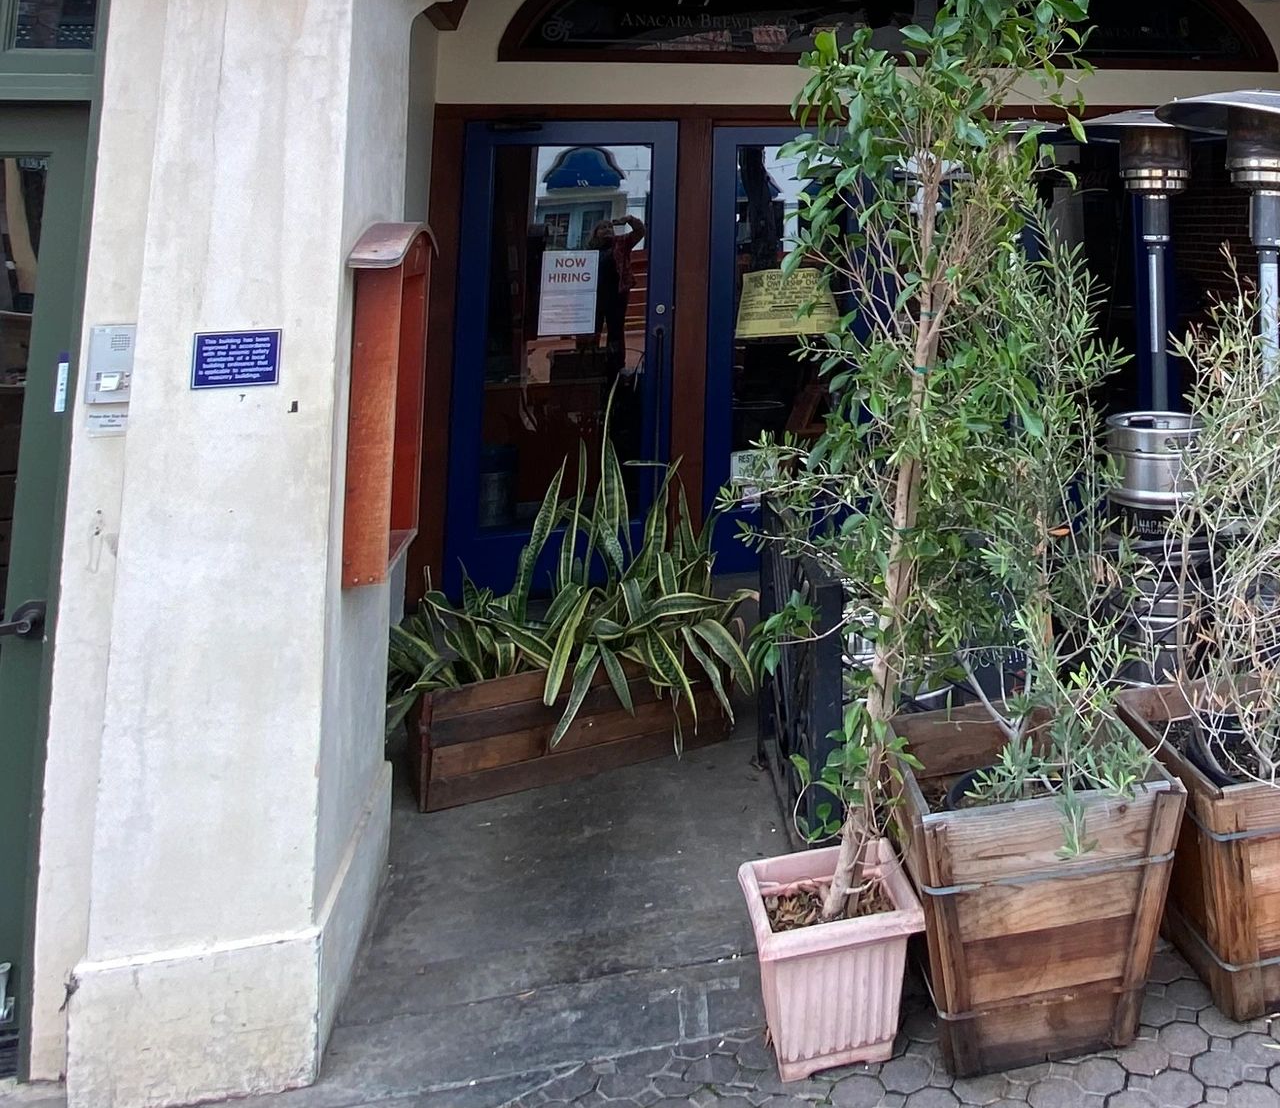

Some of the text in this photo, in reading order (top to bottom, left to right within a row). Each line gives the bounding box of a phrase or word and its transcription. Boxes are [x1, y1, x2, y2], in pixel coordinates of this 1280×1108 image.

[620, 12, 693, 28] ANACAPA
[555, 258, 587, 268] NOW
[548, 272, 591, 283] HIRING
